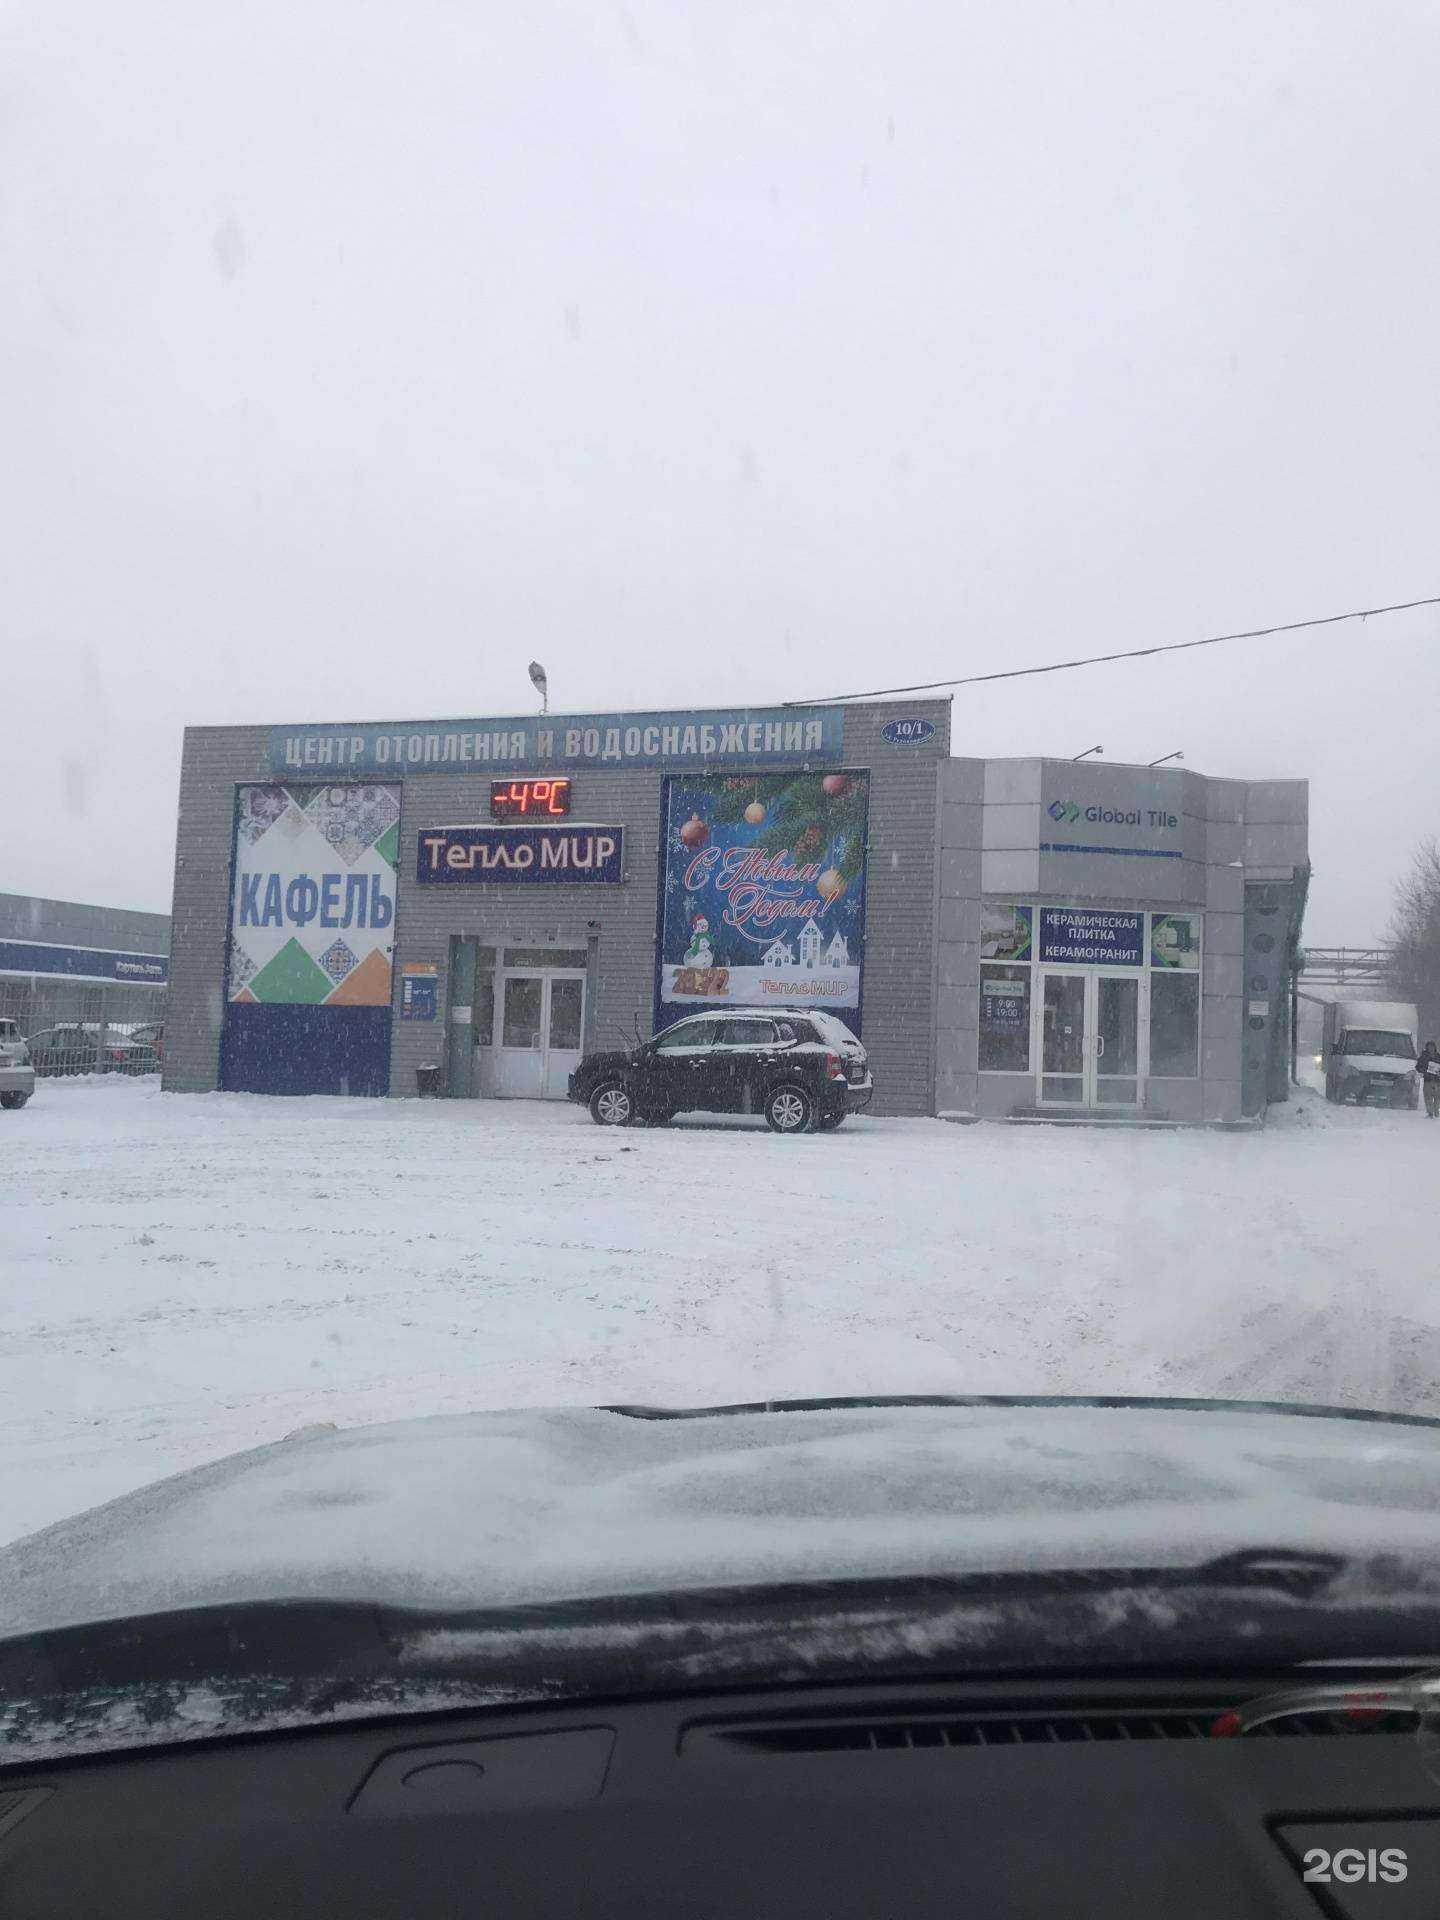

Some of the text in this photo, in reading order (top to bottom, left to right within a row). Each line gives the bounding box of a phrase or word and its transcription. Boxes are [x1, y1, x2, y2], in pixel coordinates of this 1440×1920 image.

[896, 720, 922, 736] 10/1
[285, 720, 823, 767] ЦЕНТР ОТОПЛЕНИЯ И ВОДОСНАБЖЕНИЯ
[1085, 806, 1179, 828] Global Tile
[684, 847, 822, 891] С Новым
[239, 873, 393, 929] КАФЕЛЬ
[1046, 914, 1138, 929] КЕРАМИЧЕСКАЯ
[1068, 928, 1116, 941] ПЛИТКА
[1045, 946, 1138, 960] КЕРАМОГРАНИТ
